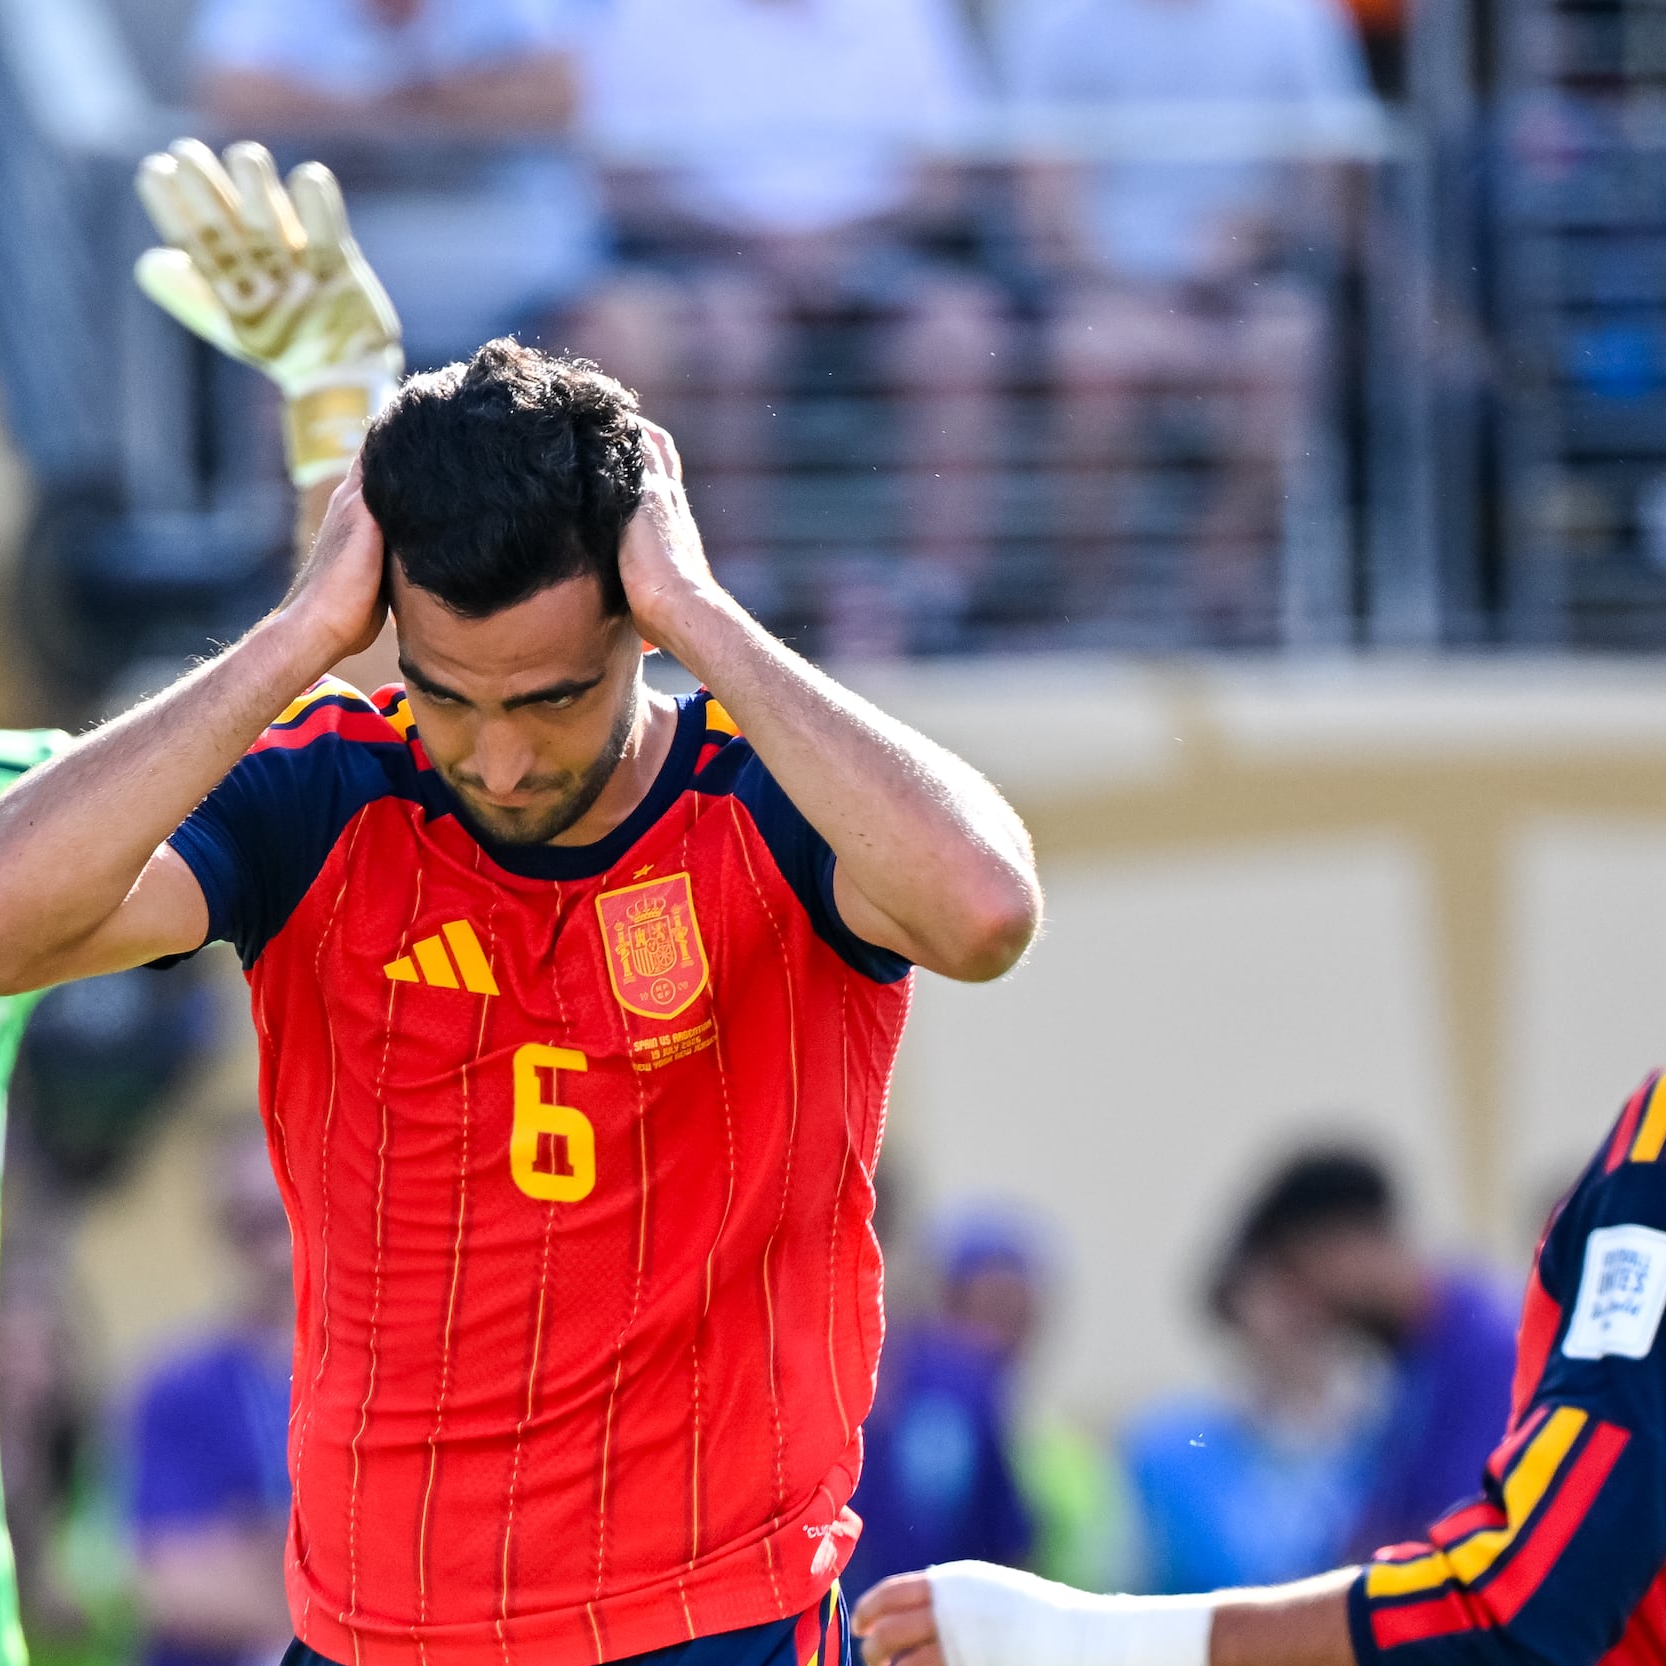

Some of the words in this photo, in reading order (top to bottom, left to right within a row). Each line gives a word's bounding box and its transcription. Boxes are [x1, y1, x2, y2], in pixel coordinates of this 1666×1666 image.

[633, 1037, 658, 1052] SPAIN
[662, 1044, 679, 1057] JULY
[510, 1043, 595, 1203] 6
